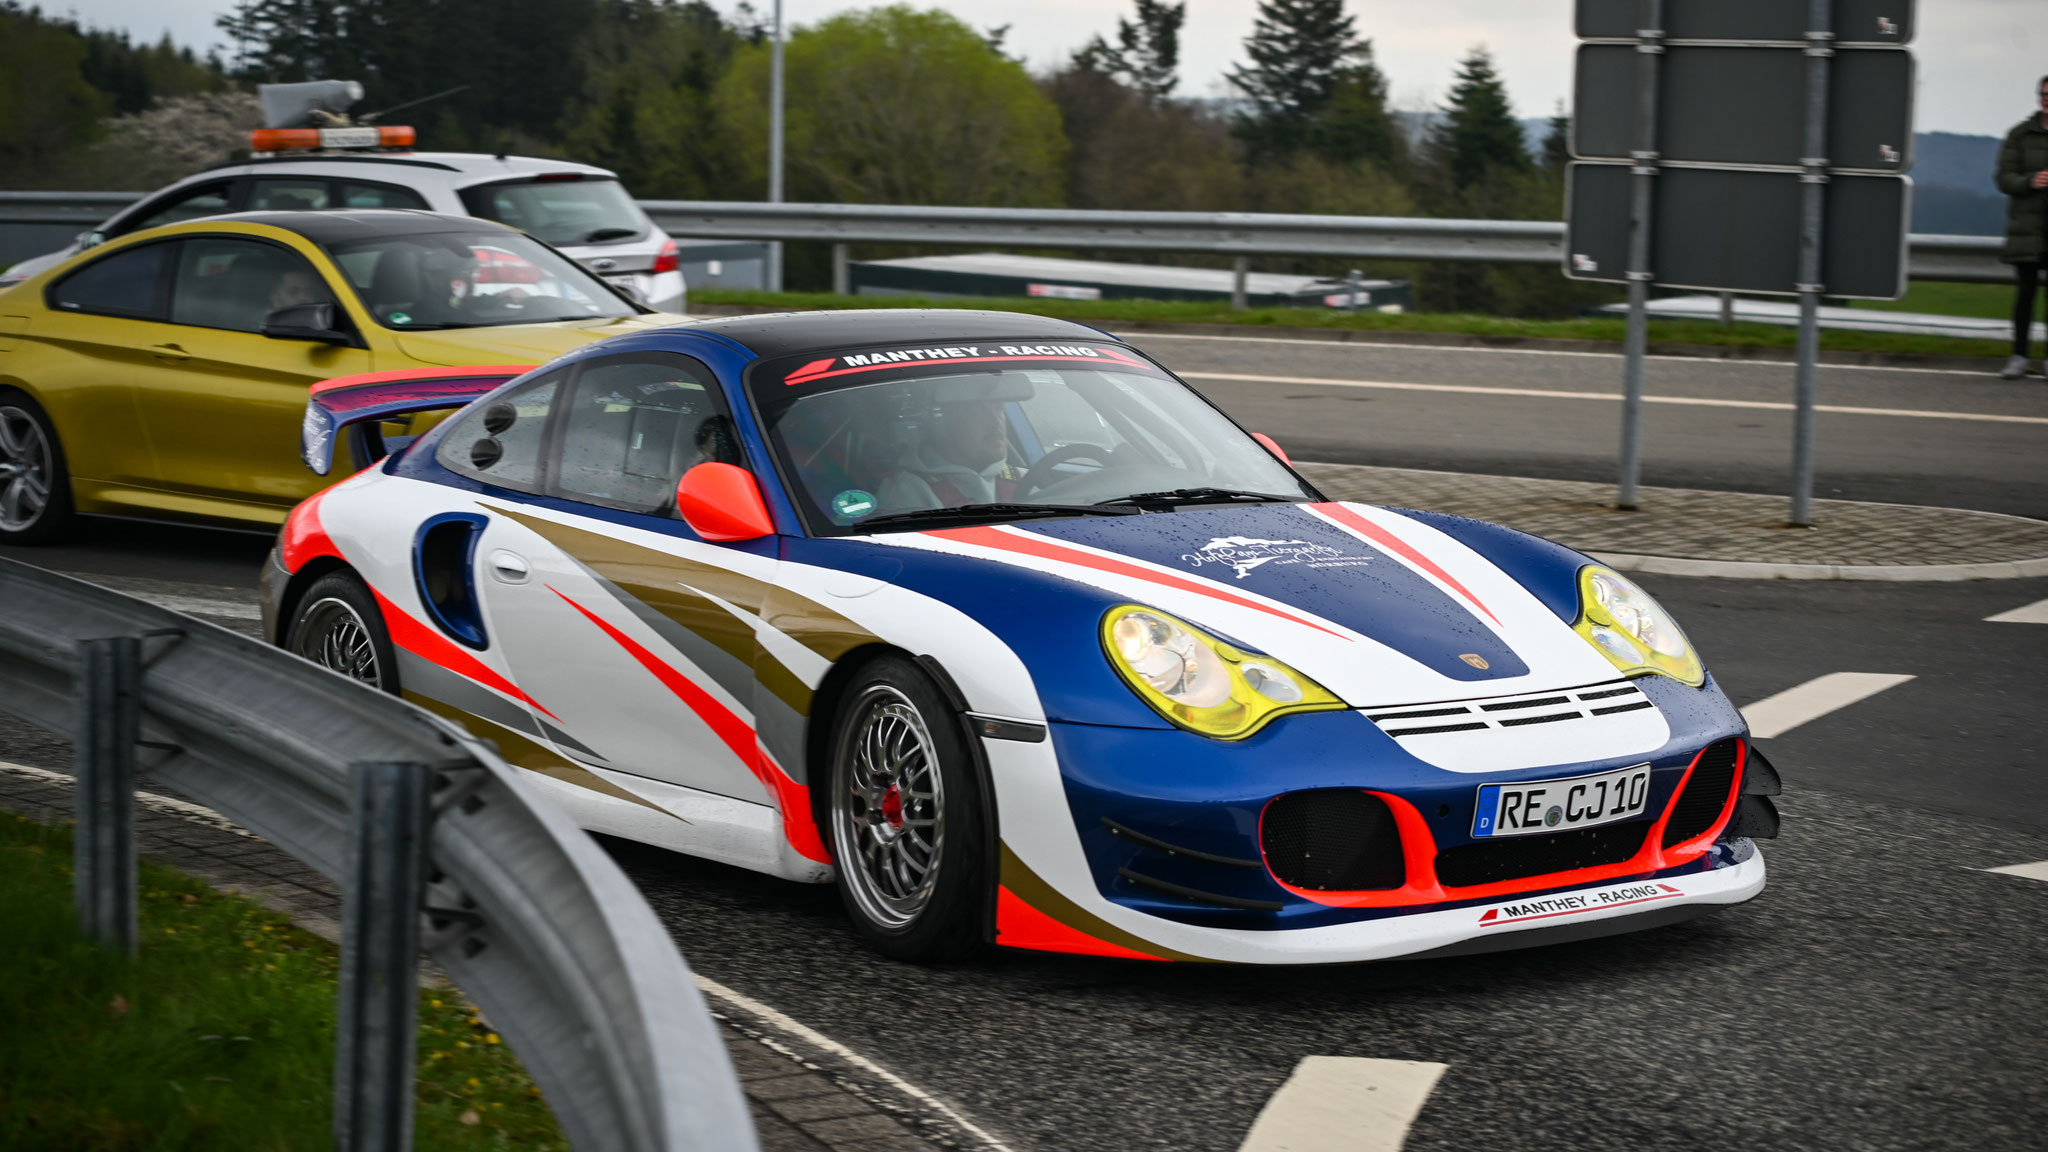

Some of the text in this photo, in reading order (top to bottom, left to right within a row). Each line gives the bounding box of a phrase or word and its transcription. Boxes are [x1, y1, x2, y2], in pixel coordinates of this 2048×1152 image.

[843, 346, 981, 367] MANTHEY
[999, 345, 1099, 357] RACING
[1181, 547, 1237, 567] Hotel
[1498, 789, 1546, 829] RE
[1480, 817, 1489, 829] D
[1503, 895, 1588, 917] MANTHEY
[1598, 885, 1658, 903] RACING
